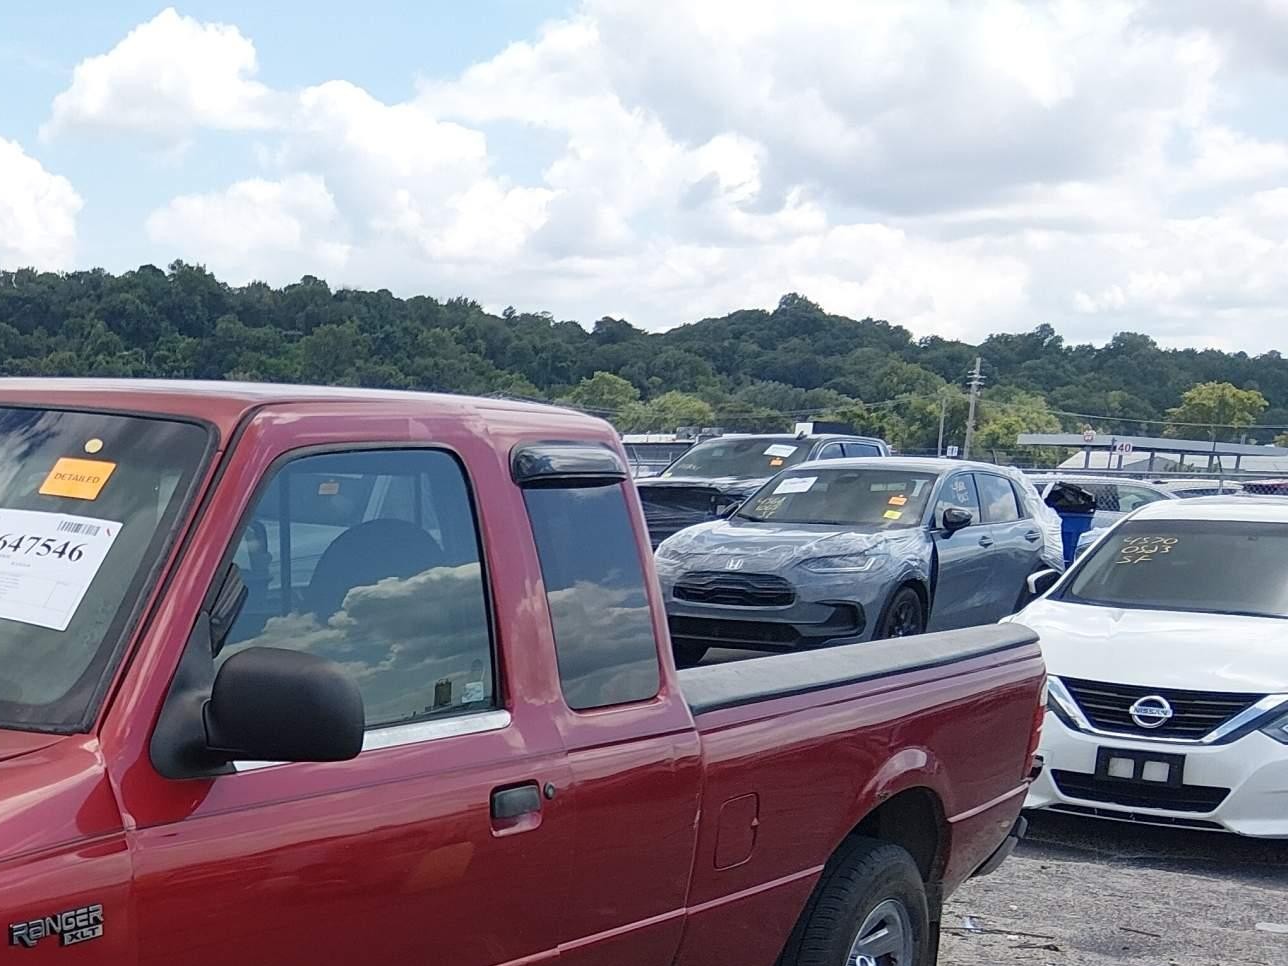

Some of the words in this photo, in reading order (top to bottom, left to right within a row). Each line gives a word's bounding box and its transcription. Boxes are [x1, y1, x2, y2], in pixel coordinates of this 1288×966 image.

[1118, 443, 1131, 453] 40
[54, 472, 101, 484] DETAILED
[69, 926, 99, 942] XLT
